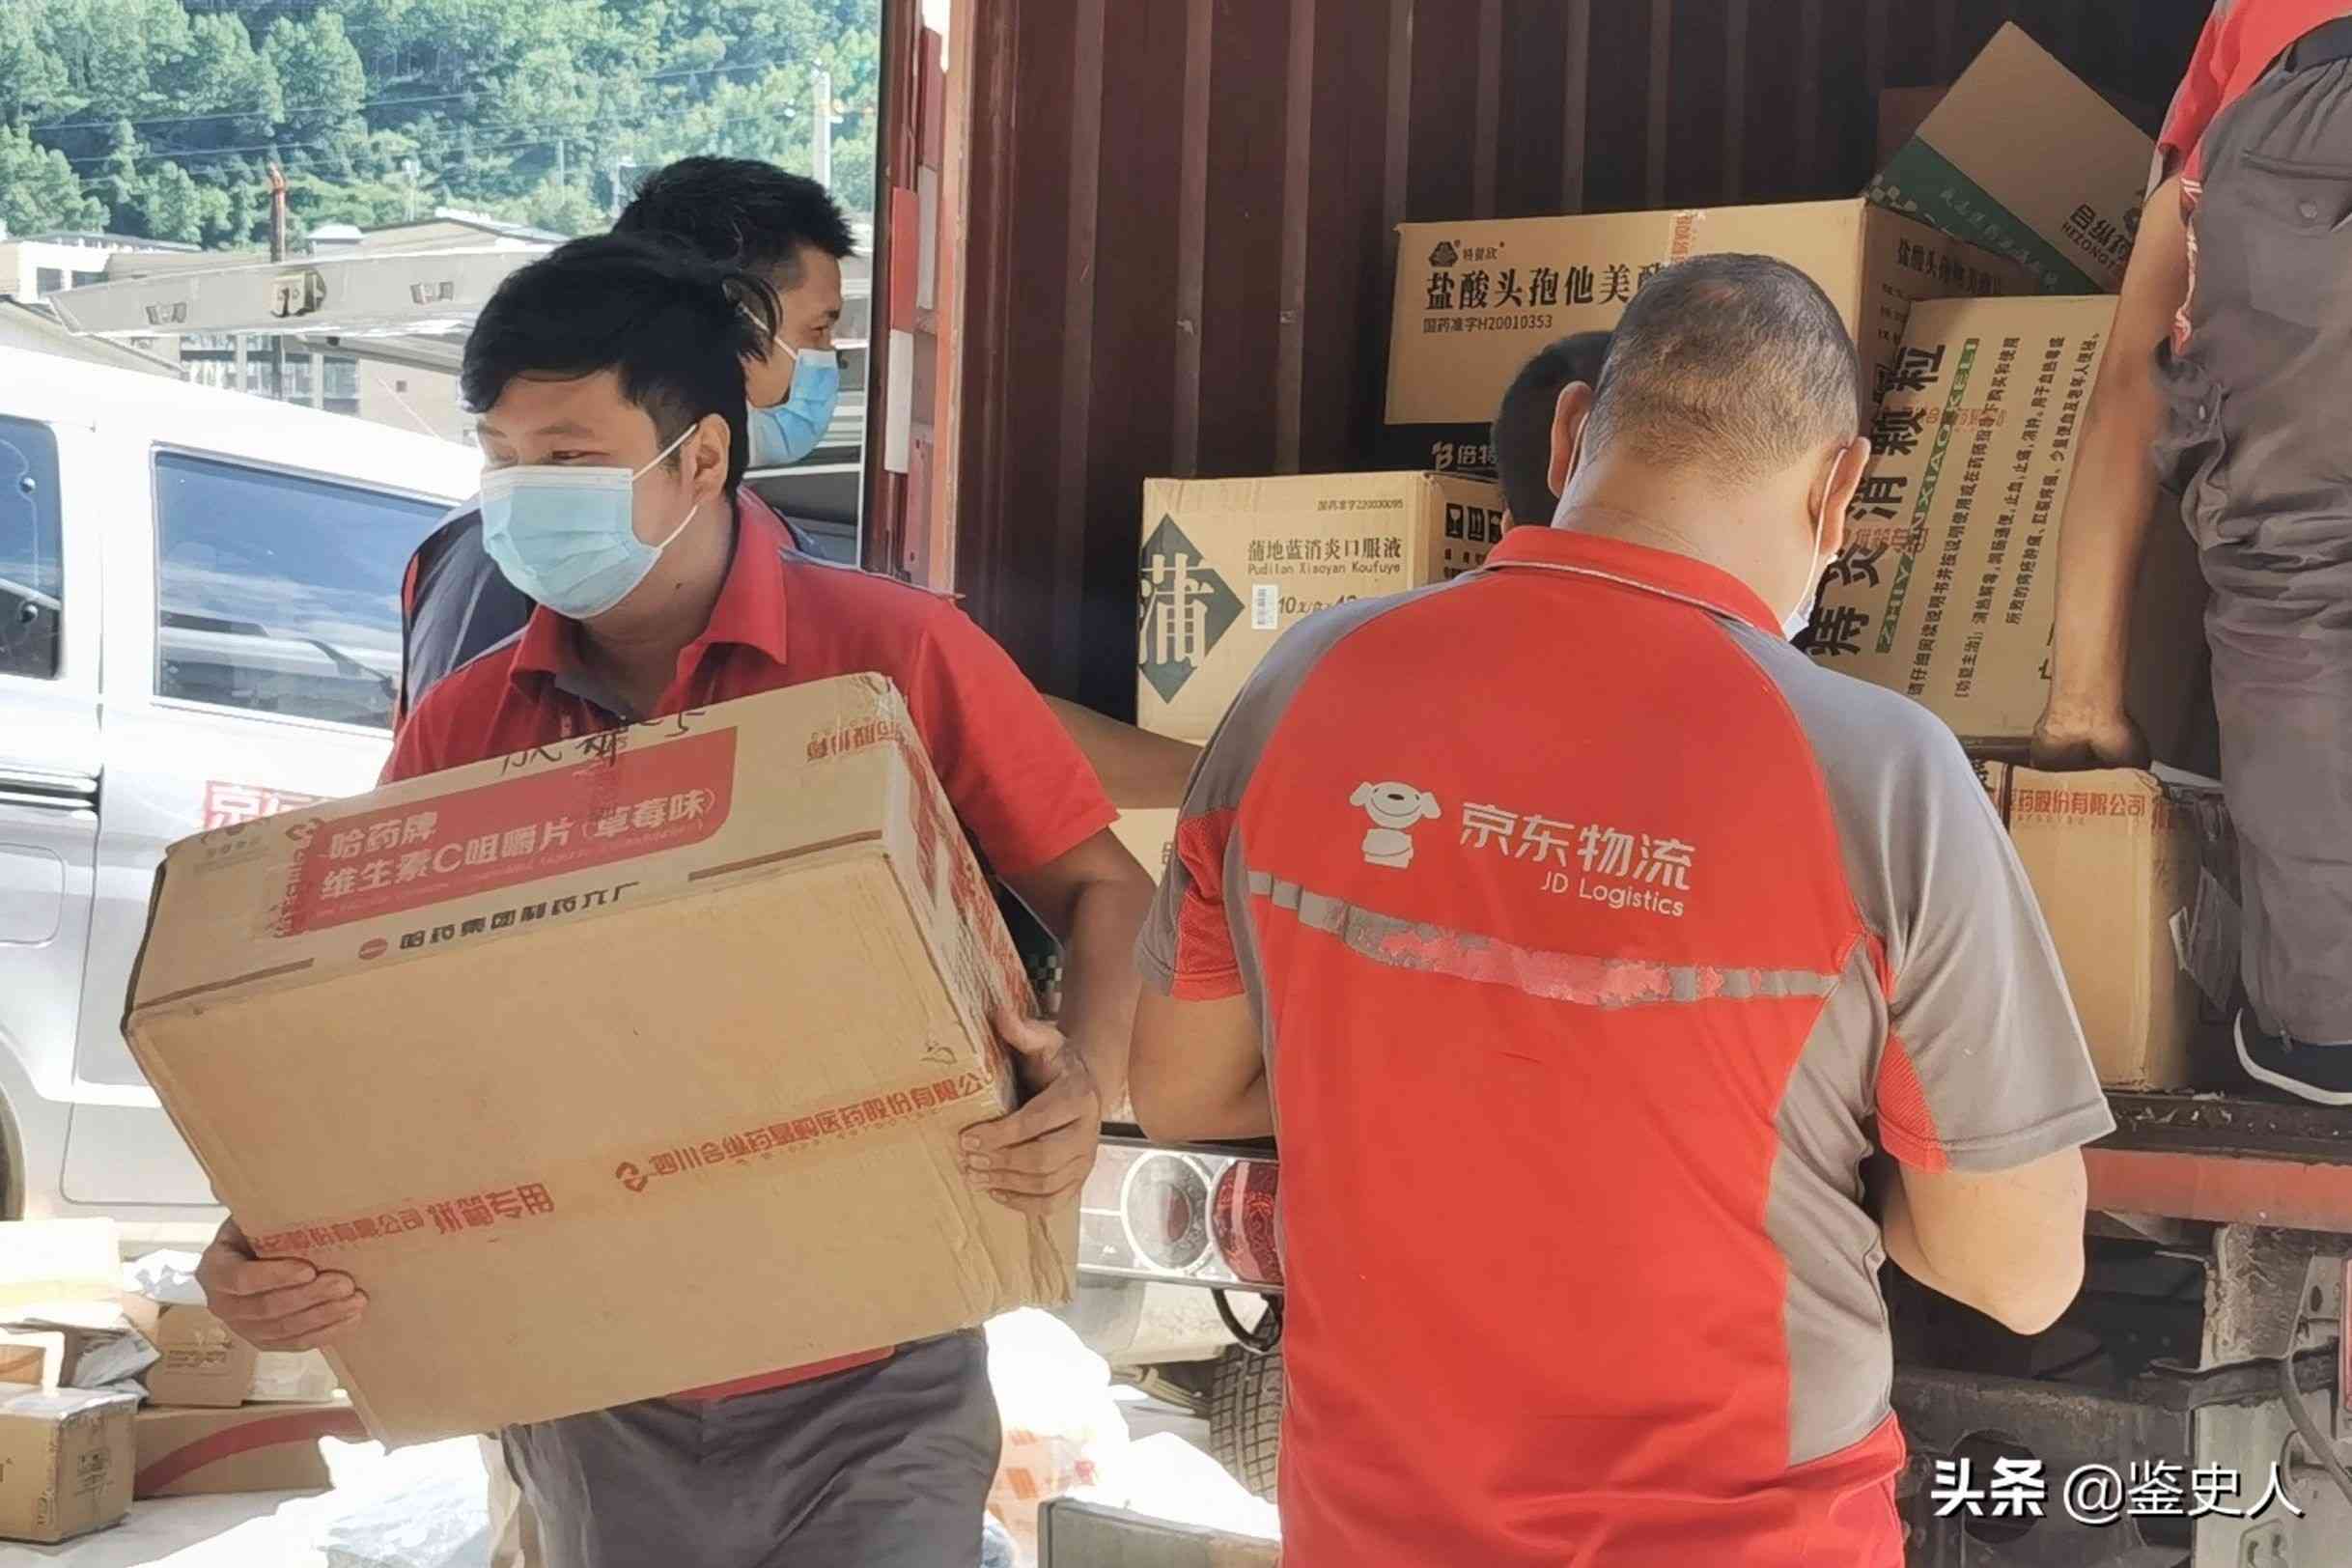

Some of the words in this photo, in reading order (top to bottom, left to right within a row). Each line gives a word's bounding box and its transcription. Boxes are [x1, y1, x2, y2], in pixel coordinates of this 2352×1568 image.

[1423, 315, 1553, 334] 国药准字H20010353
[1248, 536, 1402, 562] 蒲地蓝消炎口服液
[1299, 563, 1346, 576] Xiaoyan
[1352, 560, 1400, 574] Koufuye
[330, 811, 438, 860] 哈药牌
[1460, 801, 1695, 891] 京东物流
[1540, 871, 1570, 894] JD
[1579, 877, 1685, 917] Logistics
